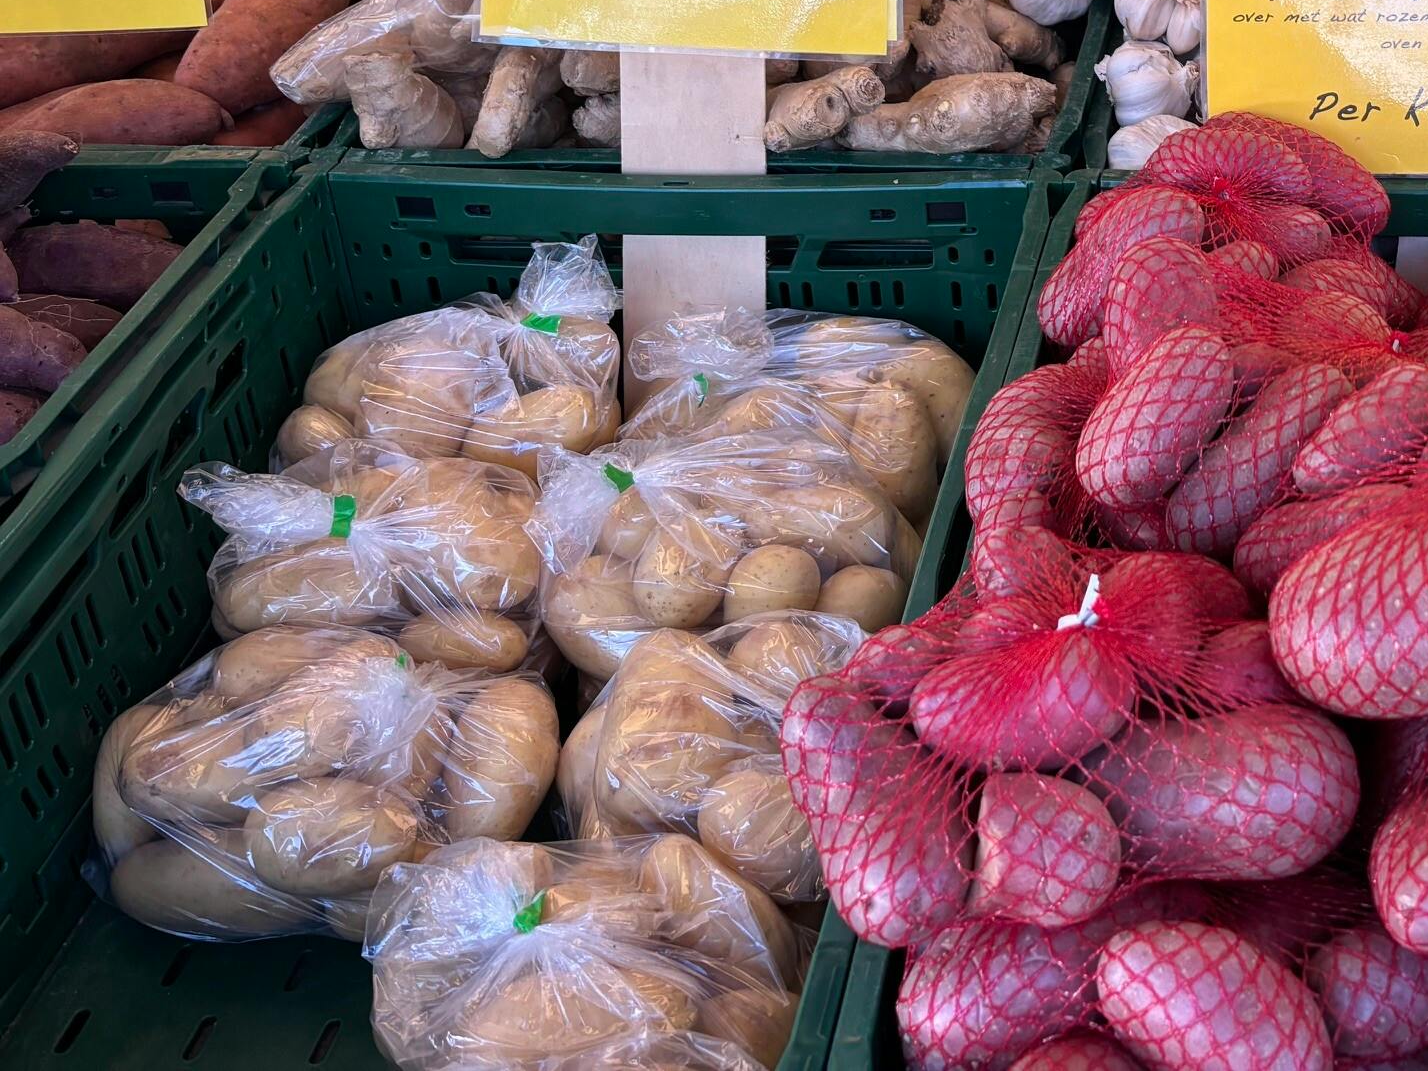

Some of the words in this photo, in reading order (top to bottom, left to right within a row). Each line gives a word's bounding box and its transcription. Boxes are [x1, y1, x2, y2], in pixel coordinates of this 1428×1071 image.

[1233, 12, 1274, 23] over
[1284, 9, 1320, 23] met
[1330, 9, 1366, 23] wat
[1380, 38, 1421, 49] oven
[1308, 89, 1381, 124] Per
